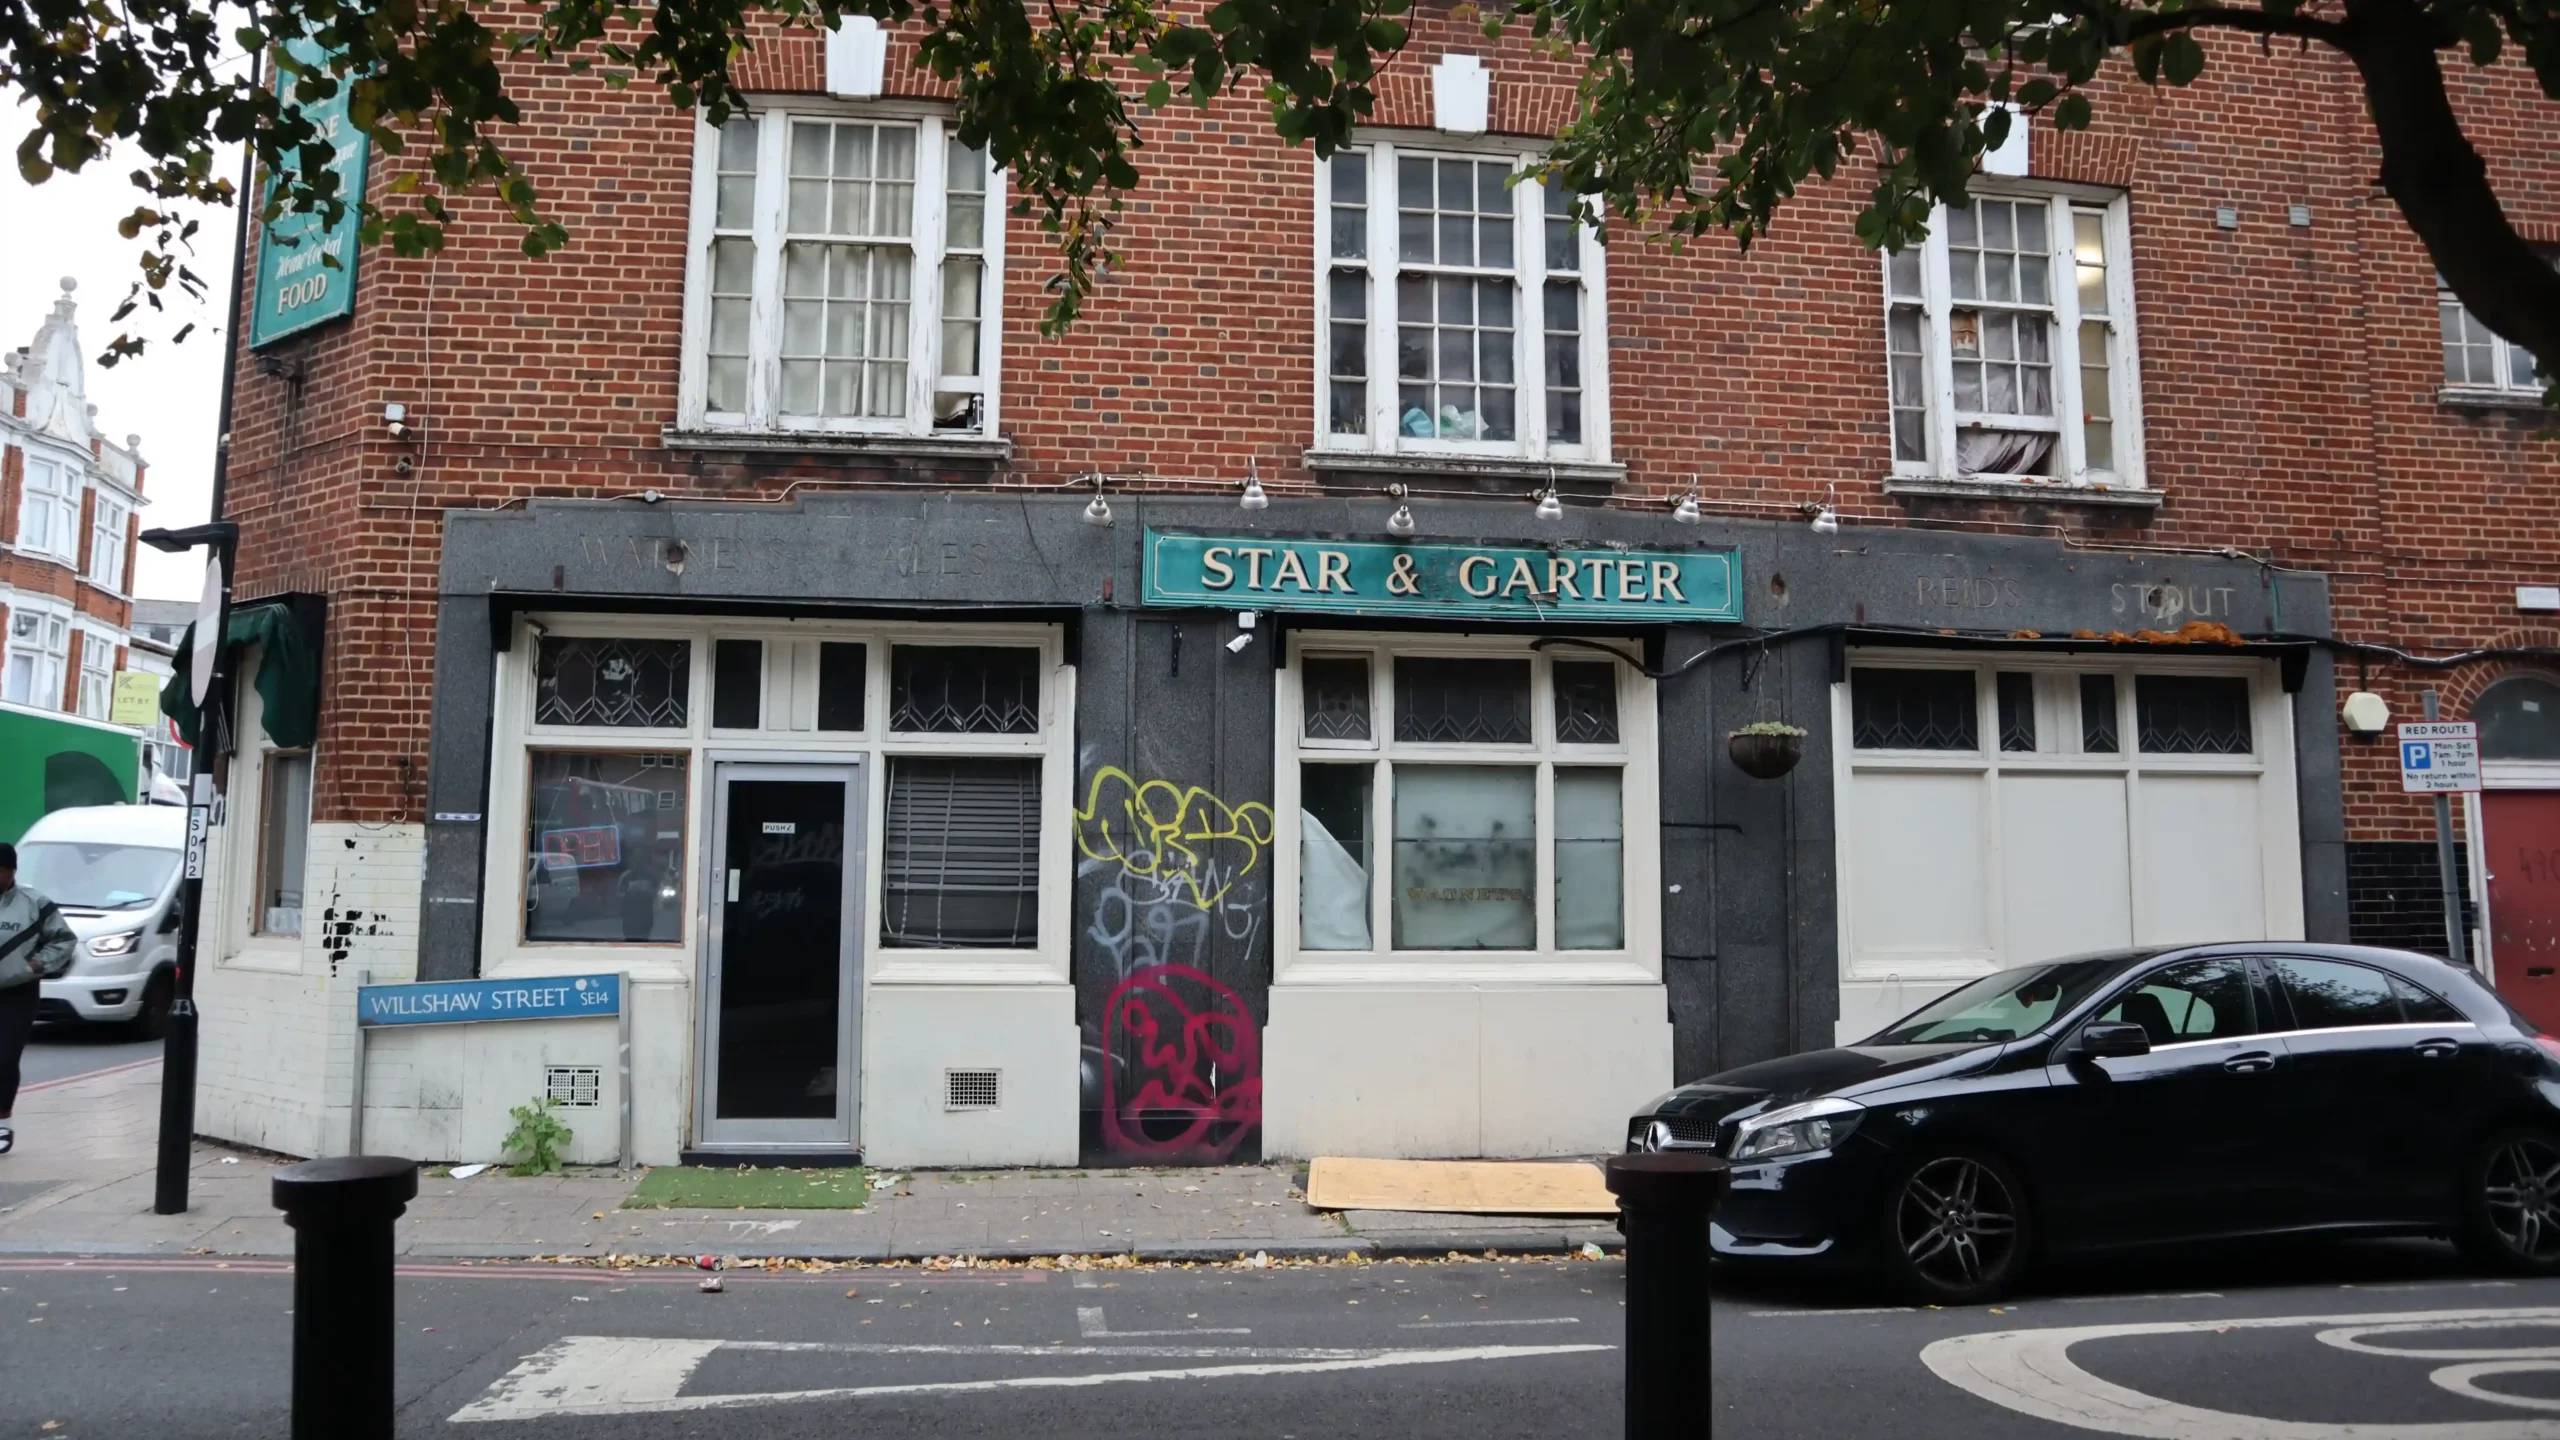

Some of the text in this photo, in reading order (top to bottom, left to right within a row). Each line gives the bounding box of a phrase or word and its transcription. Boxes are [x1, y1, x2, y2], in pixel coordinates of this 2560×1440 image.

[277, 273, 327, 315] FOOD
[880, 540, 988, 576] ALES
[1201, 547, 1688, 601] STAR & GARTER
[2111, 583, 2237, 618] STOUT
[2405, 725, 2469, 735] RED ROUTE
[2409, 745, 2427, 767] P
[2426, 781, 2432, 789] 2
[764, 824, 787, 832] PUSH
[545, 830, 616, 866] OPEN
[0, 921, 21, 932] RMY
[371, 987, 609, 1015] WILLSHAW STREET SE14
